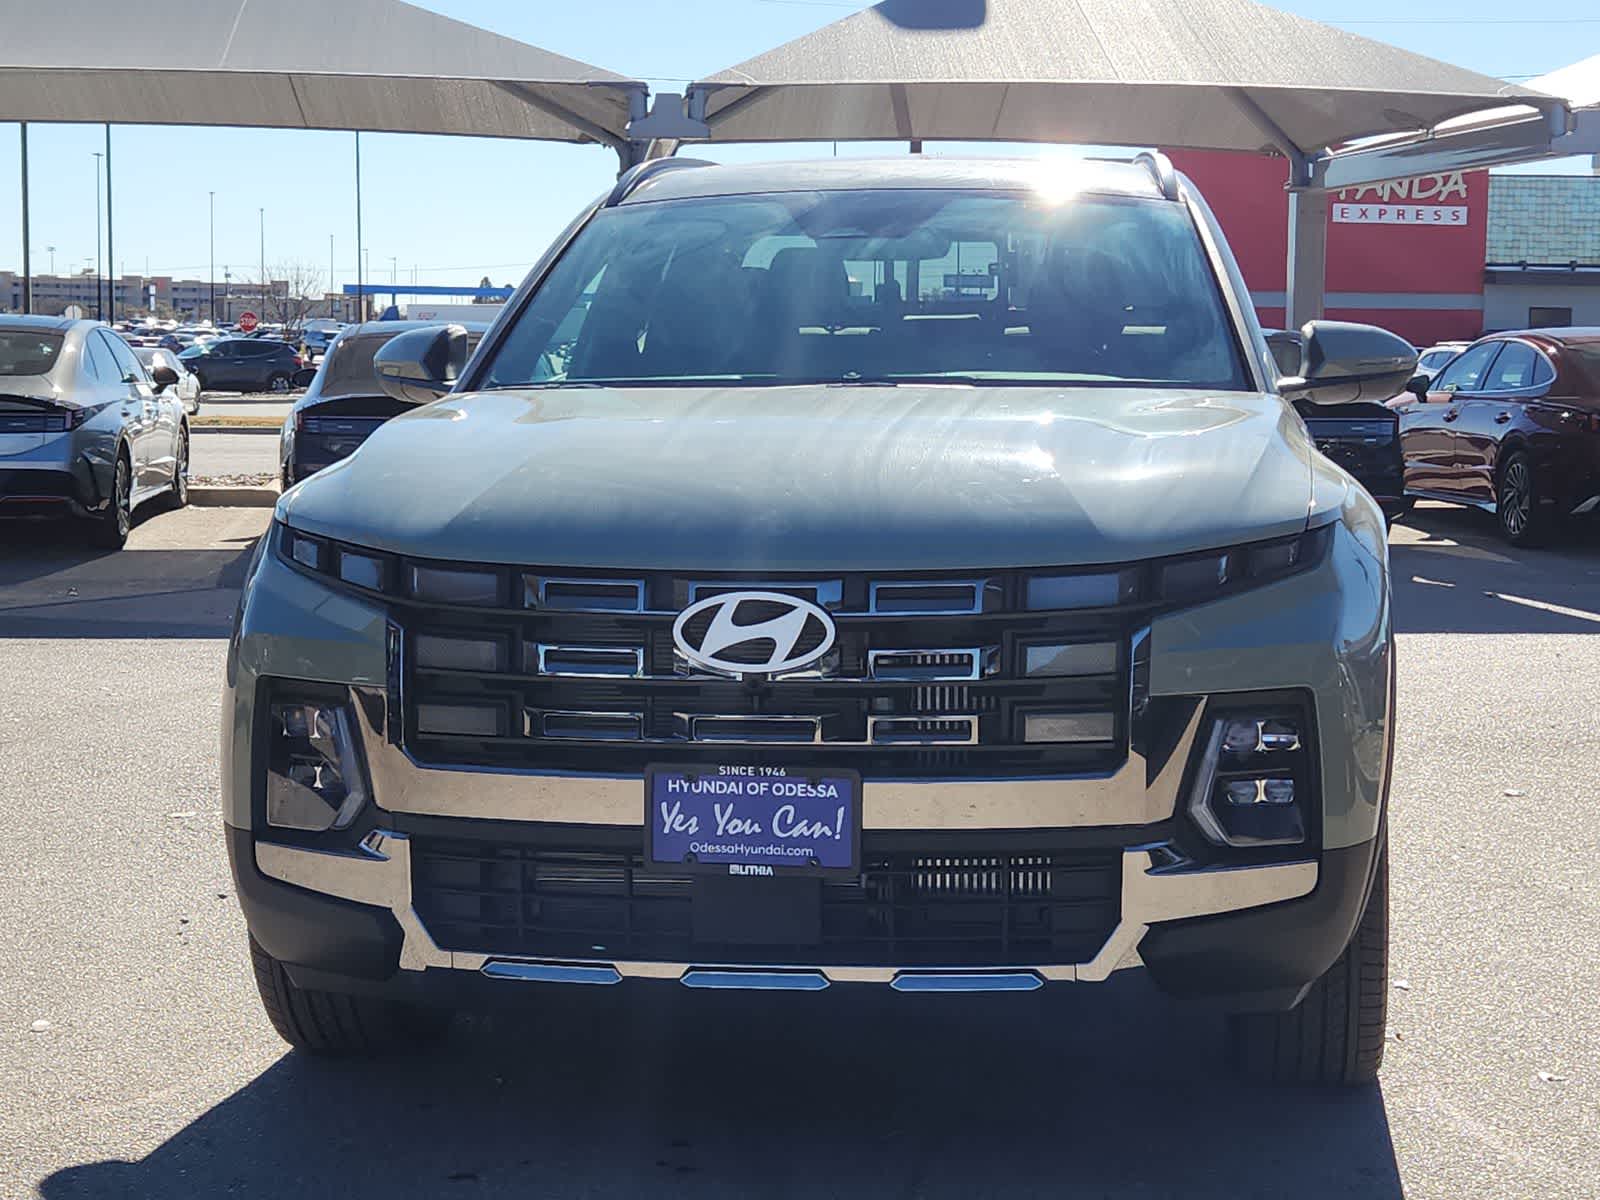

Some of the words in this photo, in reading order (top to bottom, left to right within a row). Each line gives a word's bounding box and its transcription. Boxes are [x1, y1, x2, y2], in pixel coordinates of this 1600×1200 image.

[1340, 207, 1460, 221] EXPRESS
[719, 766, 755, 776] SINCE
[759, 767, 786, 777] 1946
[668, 780, 743, 795] HYUNDAI
[747, 783, 769, 795] OF
[772, 783, 838, 798] ODESSA
[660, 801, 699, 835] Yes
[714, 803, 761, 836] You
[772, 805, 845, 840] Can!
[690, 842, 813, 857] OdessaHyundai.com
